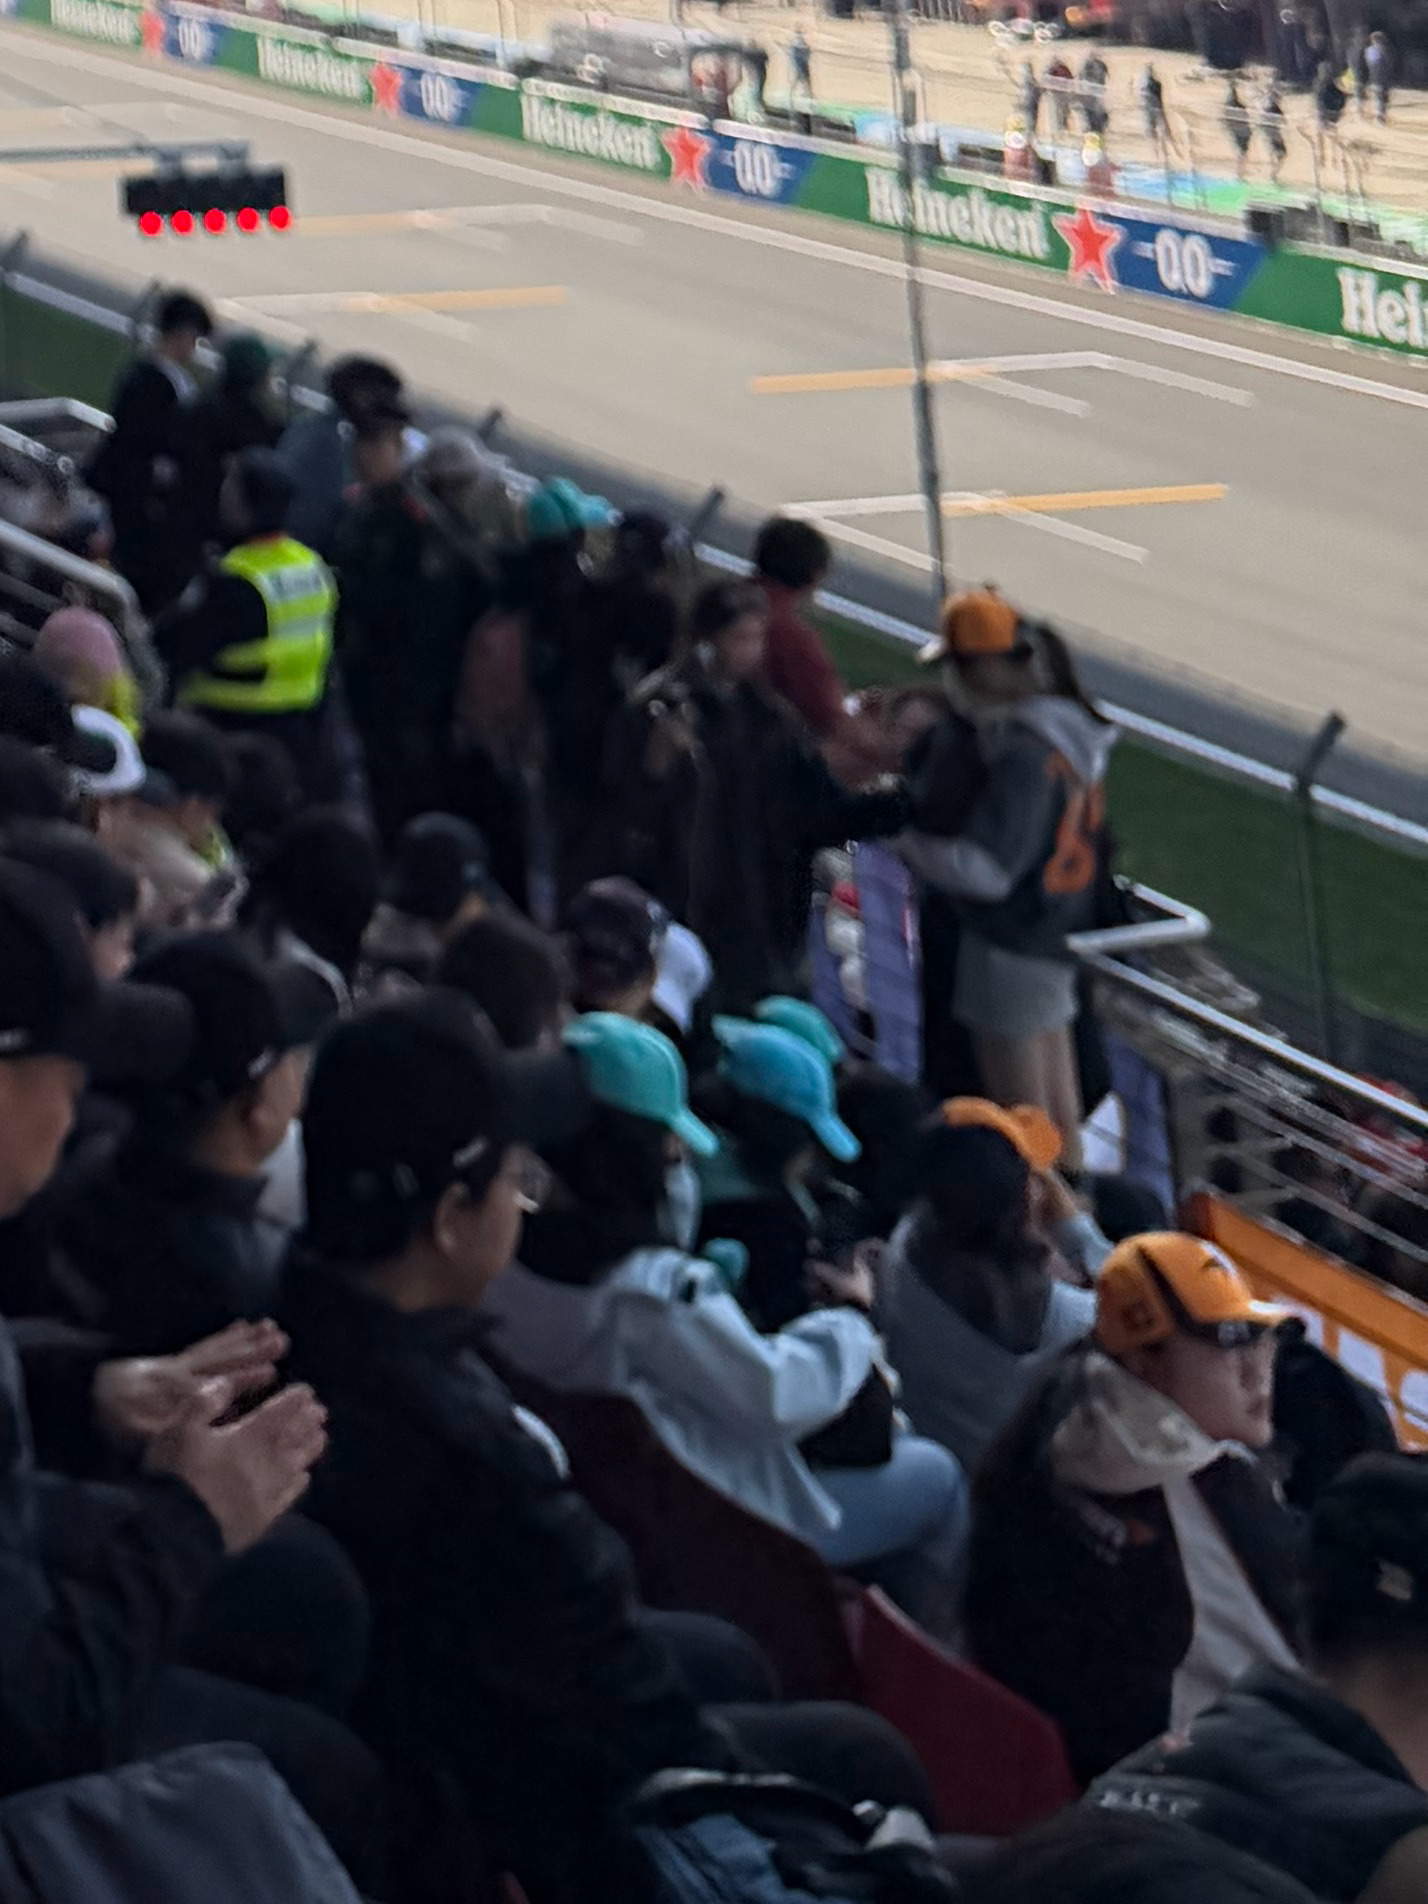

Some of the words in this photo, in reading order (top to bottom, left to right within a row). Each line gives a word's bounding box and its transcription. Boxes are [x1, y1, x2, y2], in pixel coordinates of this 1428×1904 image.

[521, 92, 661, 171] Heineken
[864, 166, 1050, 260] Heineken
[1335, 266, 1428, 350] Hei
